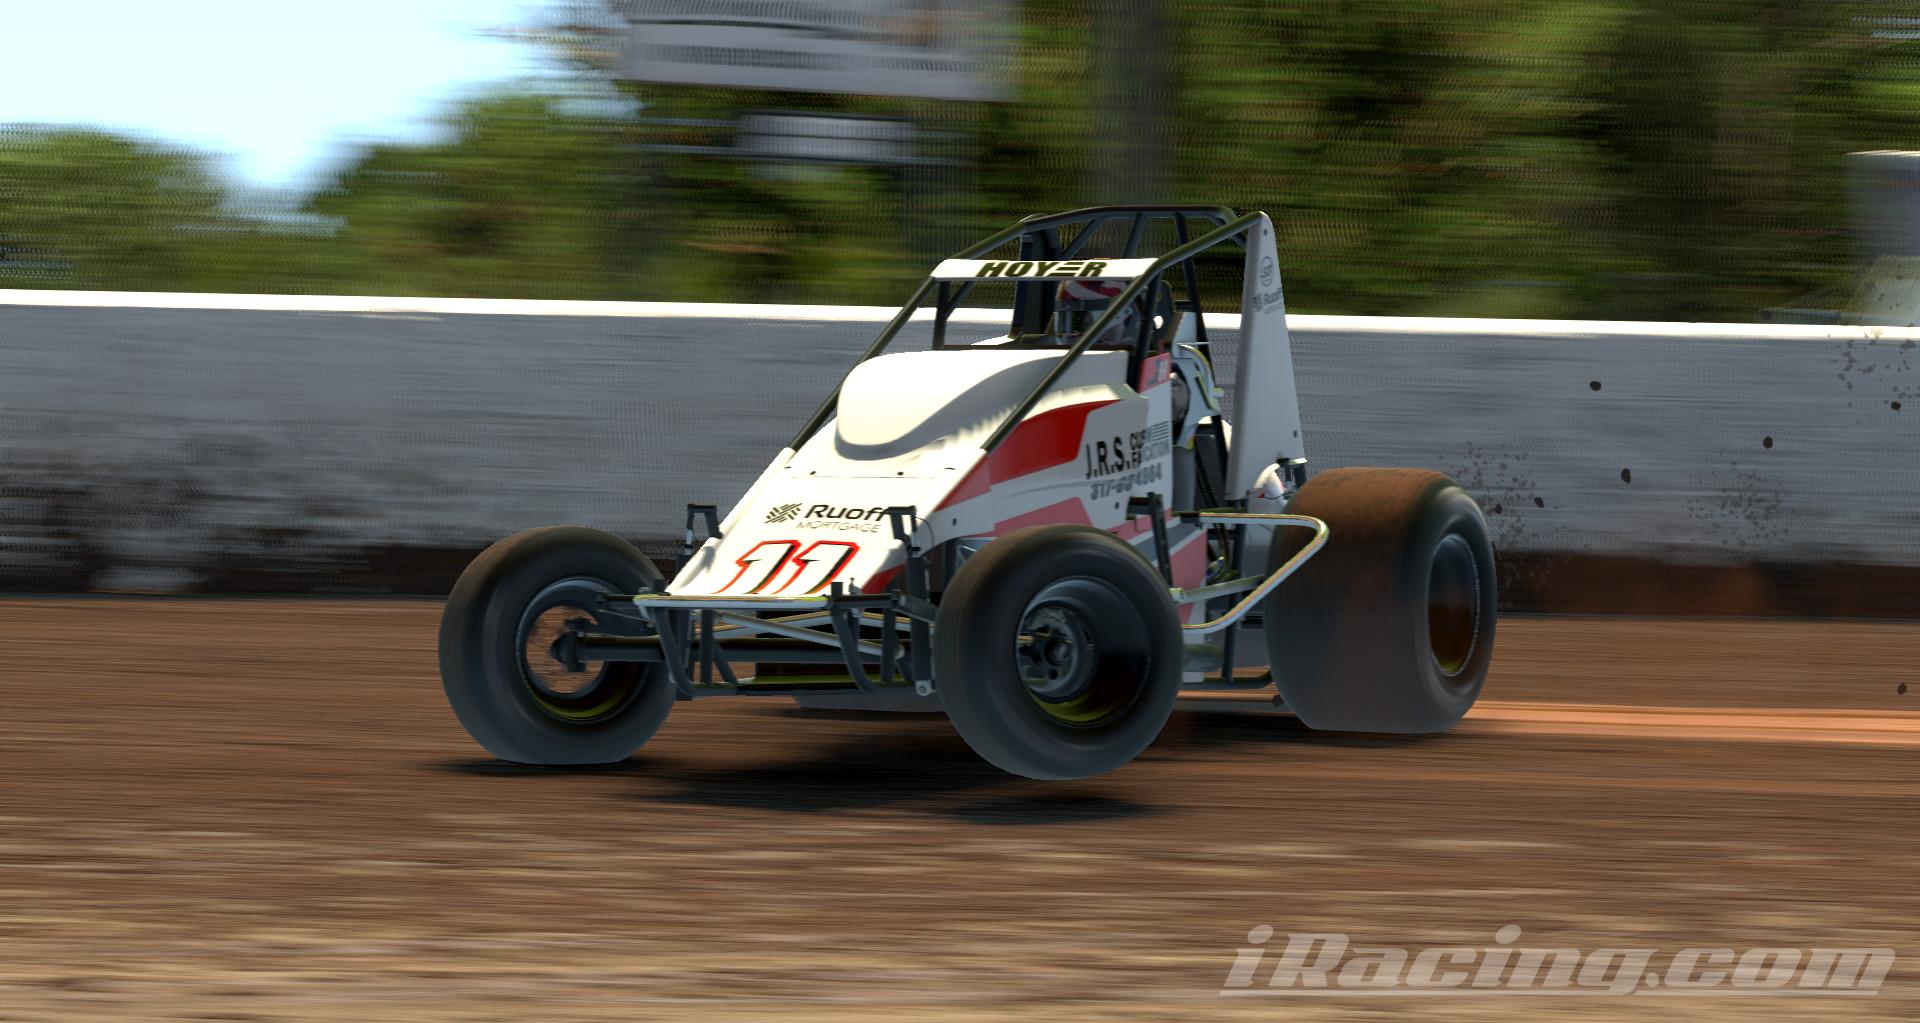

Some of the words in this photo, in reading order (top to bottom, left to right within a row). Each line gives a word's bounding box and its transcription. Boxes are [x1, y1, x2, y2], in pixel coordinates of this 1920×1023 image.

[976, 261, 1107, 277] HOYER
[1086, 436, 1131, 480] J.R.S.
[805, 504, 889, 521] Ruoff
[797, 520, 881, 533] MORTGAGE
[711, 540, 860, 595] 11
